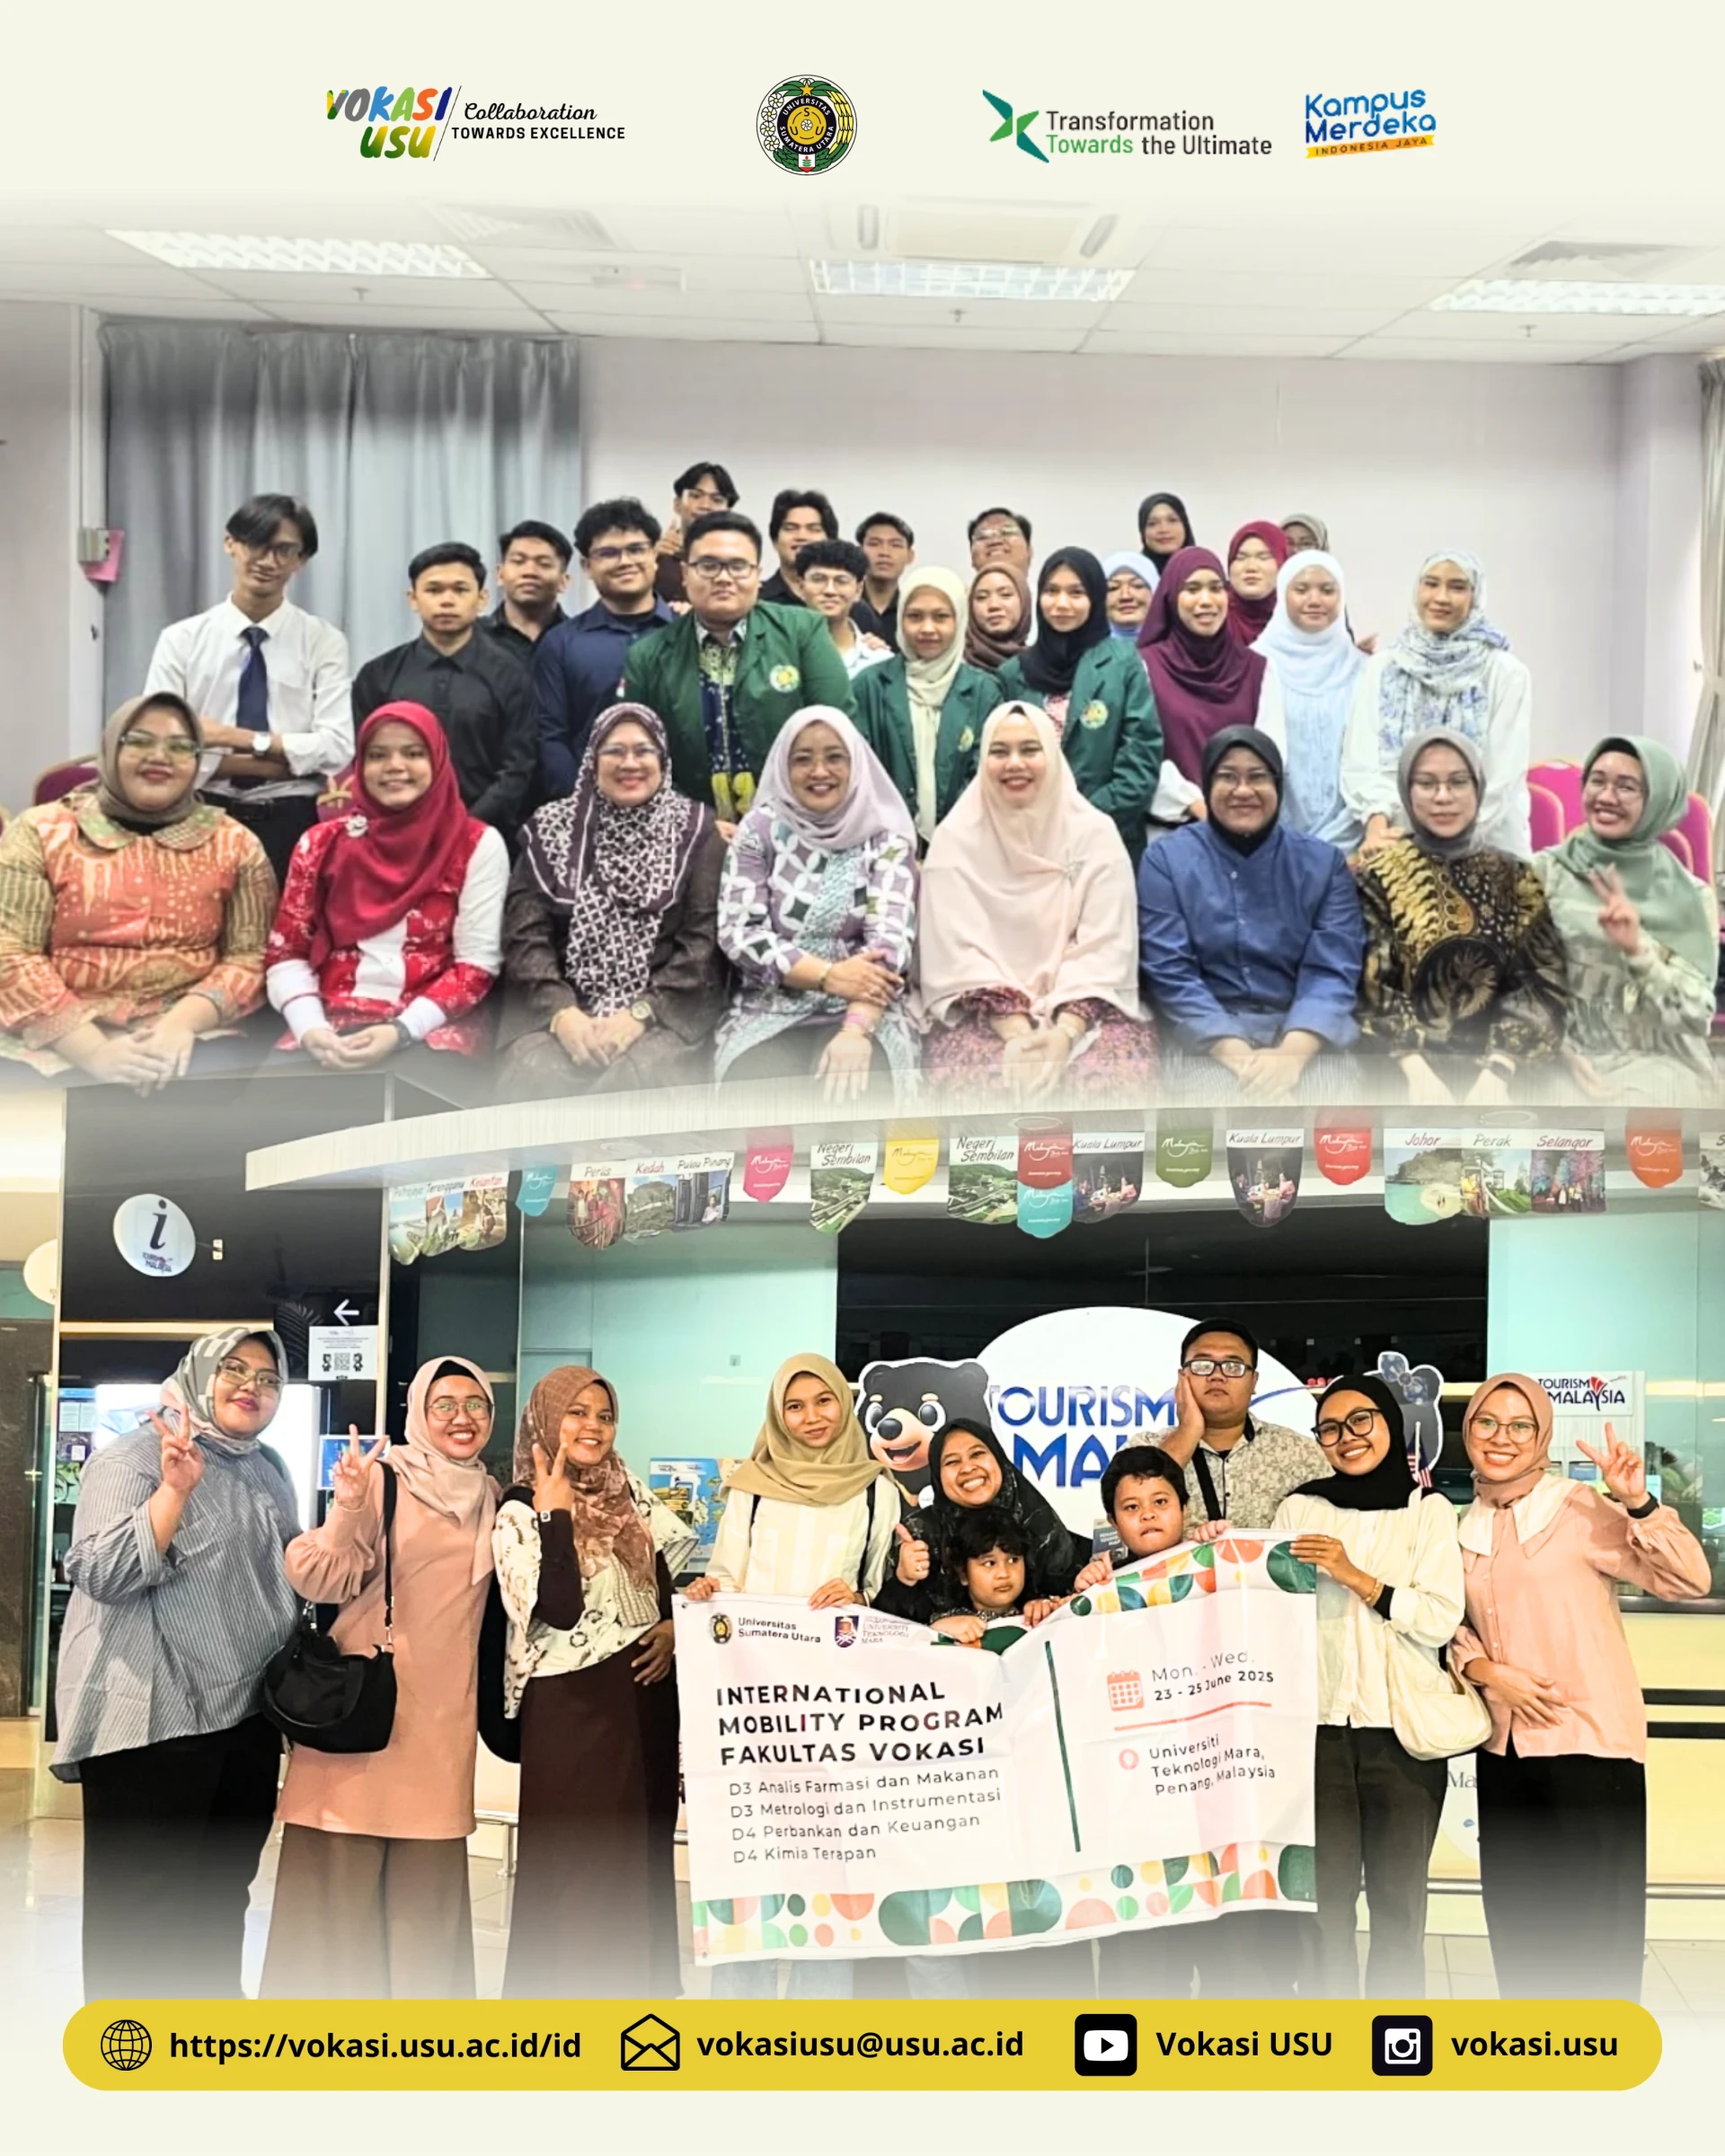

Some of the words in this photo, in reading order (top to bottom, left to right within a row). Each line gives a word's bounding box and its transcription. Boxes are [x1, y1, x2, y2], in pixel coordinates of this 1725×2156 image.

[1074, 1138, 1101, 1149] Kuala
[1103, 1137, 1143, 1150] Lumpur
[1228, 1133, 1258, 1144] Kuala
[1261, 1132, 1302, 1146] Lumpur
[1405, 1132, 1441, 1146] Johor
[1473, 1134, 1511, 1147] Perak
[1536, 1135, 1593, 1150] Selangor
[821, 1153, 871, 1167] Sembilan
[960, 1150, 1014, 1162] Sembilan
[635, 1161, 665, 1175] Kedah
[1538, 1378, 1590, 1390] TOURISM
[739, 1617, 797, 1630] Universitas
[738, 1628, 789, 1639] Sumatera
[791, 1632, 821, 1643] Utara
[1152, 1665, 1199, 1683] Mon.
[717, 1682, 945, 1706] INTERNATIONAL
[1154, 1689, 1172, 1701] 23
[1188, 1683, 1203, 1696] 25
[1205, 1674, 1232, 1691] June
[1237, 1670, 1274, 1683] 2025
[719, 1713, 845, 1736] MOBILITY
[859, 1702, 1003, 1732] PROGRAM
[721, 1743, 855, 1765] FAKULTAS
[869, 1736, 984, 1762] VOKASI
[1149, 1734, 1220, 1759] Universiti
[1151, 1752, 1222, 1779] Teknologi
[1225, 1747, 1265, 1761] Mara,
[730, 1782, 752, 1796] D3
[758, 1780, 801, 1794] Analis
[806, 1777, 870, 1793] Farmasi
[876, 1775, 910, 1789] dan
[917, 1767, 999, 1786] Makanan
[1155, 1777, 1215, 1796] Penang,
[1216, 1765, 1276, 1782] Malaysia
[730, 1804, 753, 1818] D3
[760, 1803, 829, 1817] Metrologi
[834, 1801, 866, 1816] dan
[872, 1788, 1001, 1812] Instrumentasi
[732, 1827, 756, 1841] D4
[763, 1825, 842, 1838] Perbankan
[848, 1824, 880, 1837] dan
[888, 1815, 980, 1833] Keuangan
[734, 1851, 757, 1863] D4
[765, 1847, 809, 1860] Kimia
[812, 1847, 876, 1864] Terapan
